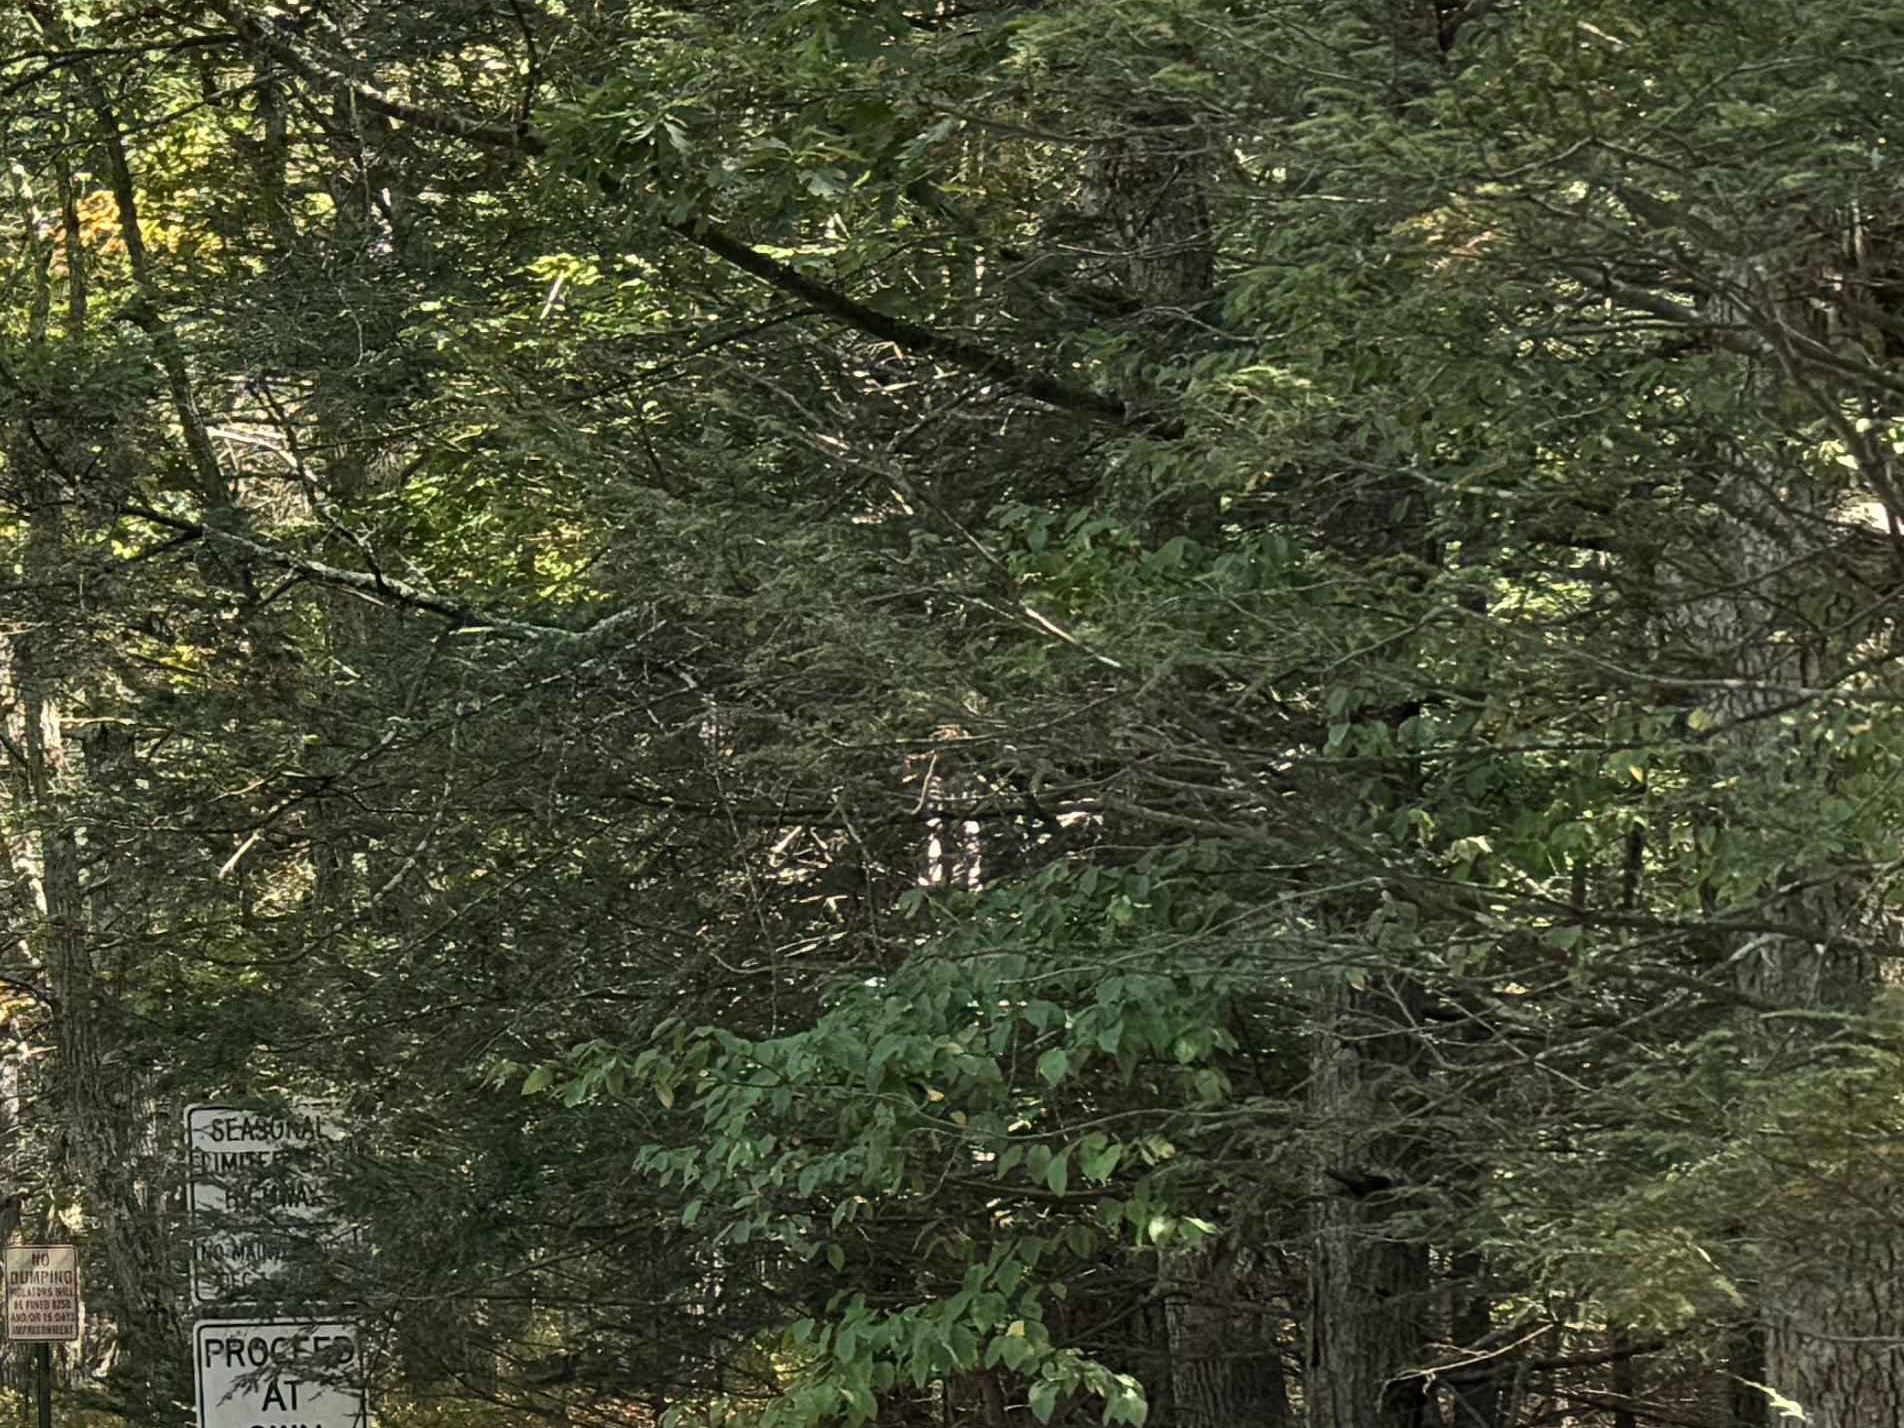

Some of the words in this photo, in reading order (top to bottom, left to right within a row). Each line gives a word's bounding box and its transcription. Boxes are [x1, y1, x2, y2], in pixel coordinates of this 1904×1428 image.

[32, 1253, 49, 1266] NO
[10, 1270, 72, 1285] DUMPING
[262, 1376, 307, 1411] AT
